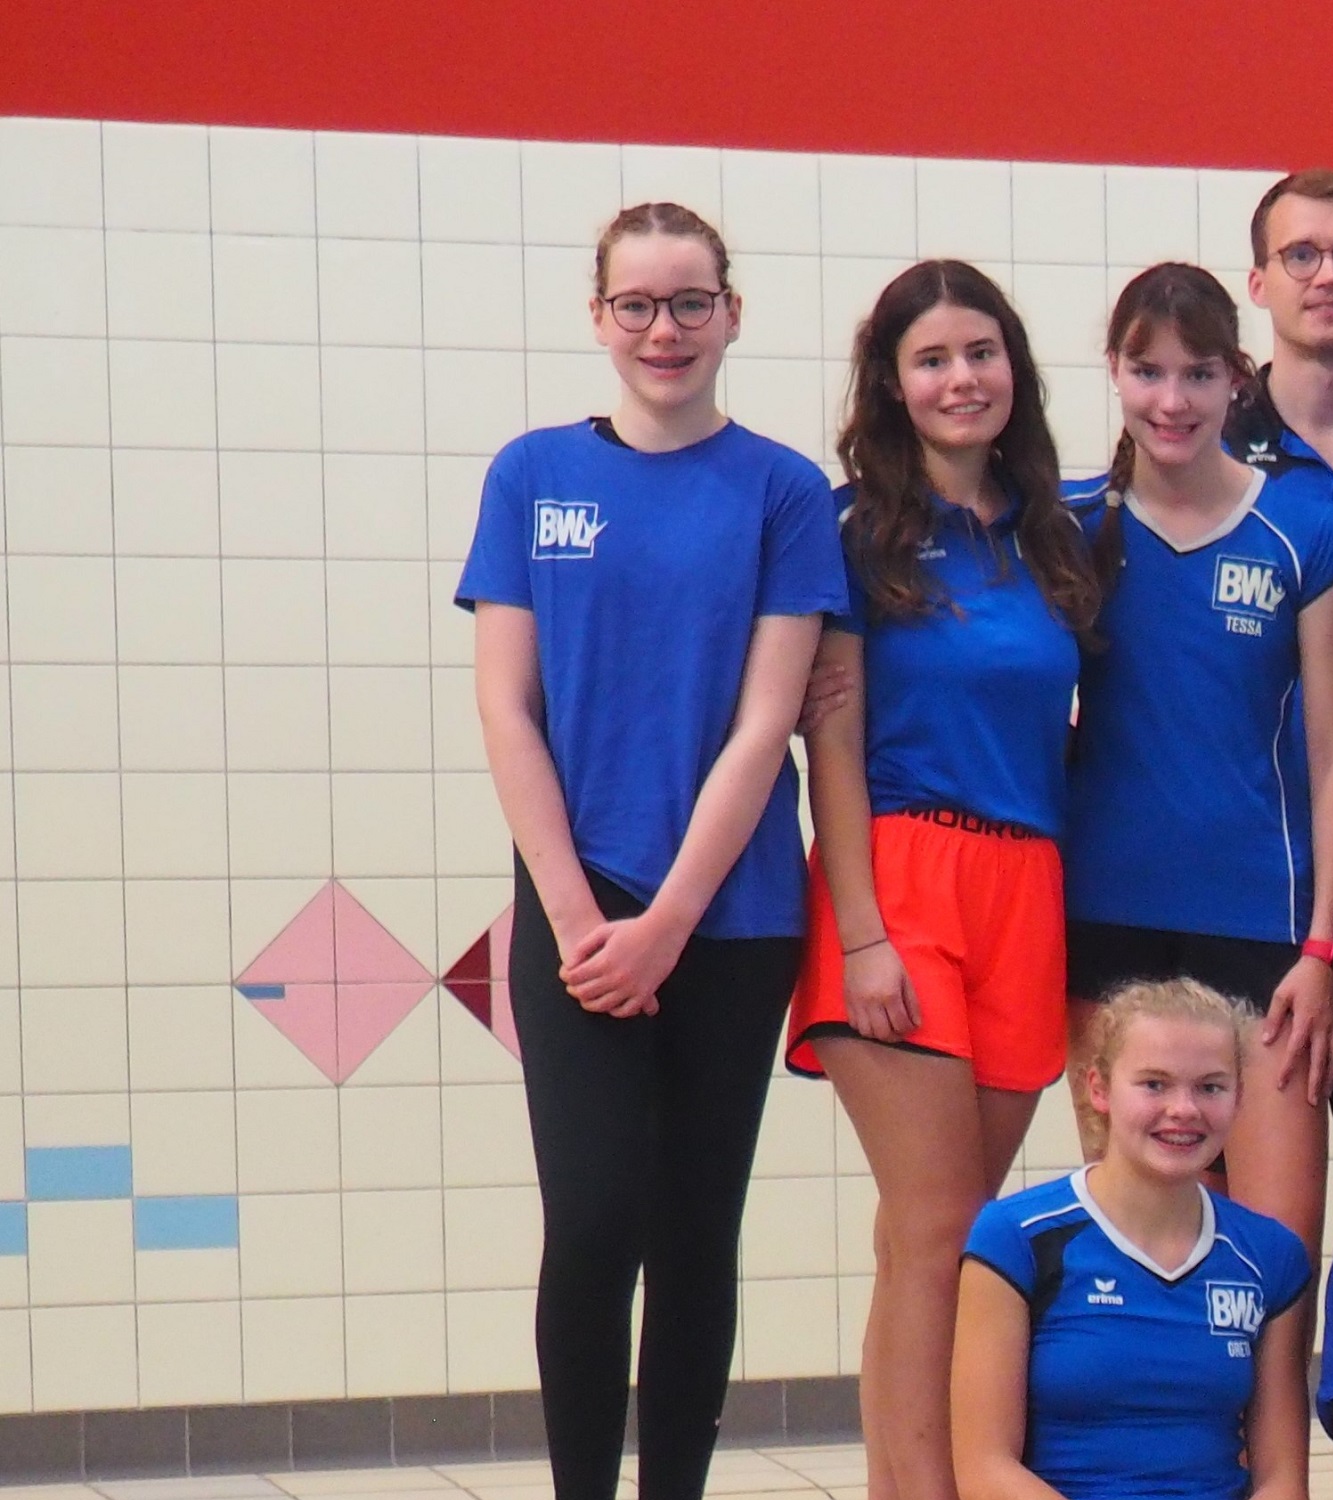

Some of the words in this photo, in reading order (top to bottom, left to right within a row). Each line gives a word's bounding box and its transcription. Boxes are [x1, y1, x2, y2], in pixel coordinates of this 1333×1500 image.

[539, 506, 593, 548] BWL
[1218, 563, 1281, 613] BWL
[1226, 616, 1262, 637] TESSA
[1087, 1293, 1124, 1305] erima
[1212, 1288, 1262, 1333] BWL
